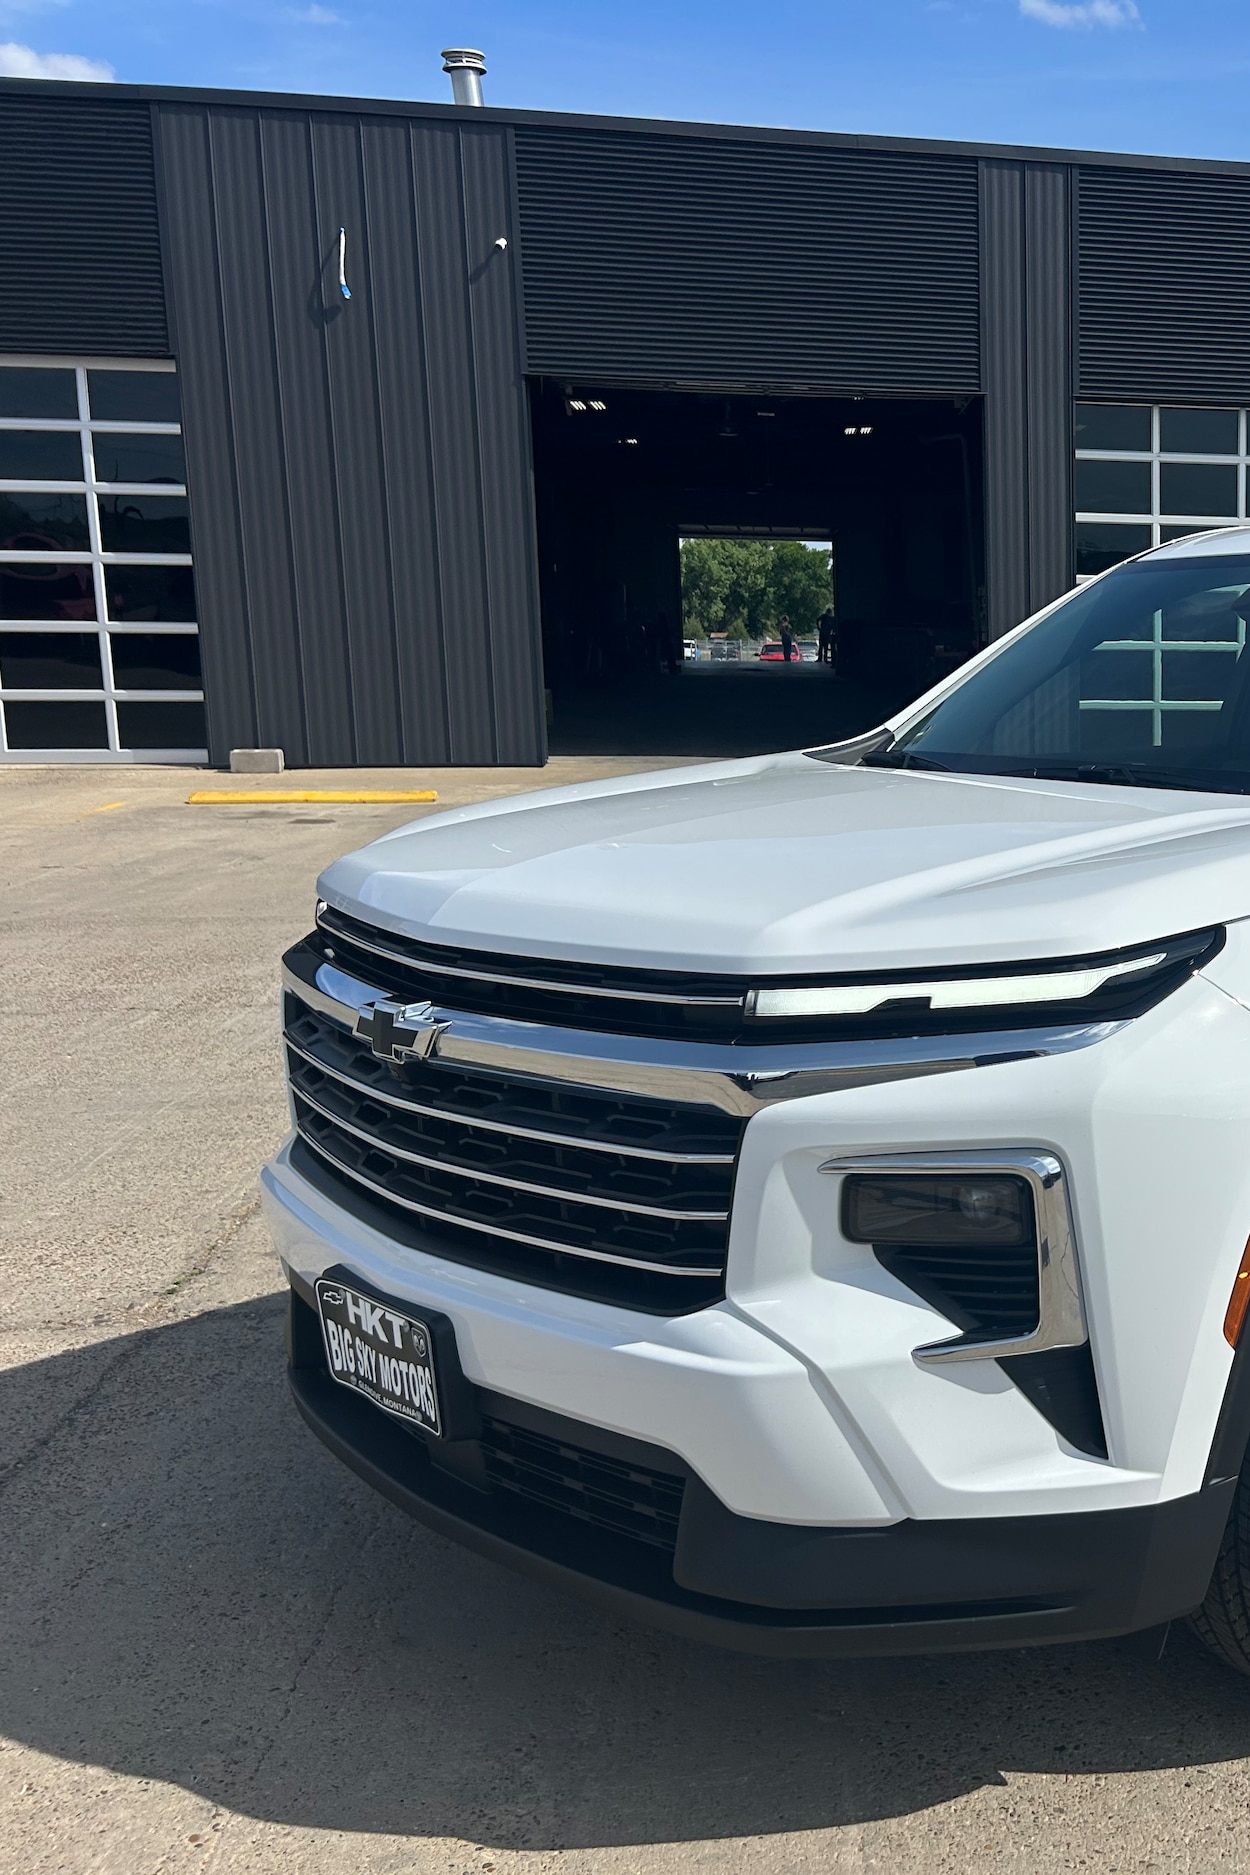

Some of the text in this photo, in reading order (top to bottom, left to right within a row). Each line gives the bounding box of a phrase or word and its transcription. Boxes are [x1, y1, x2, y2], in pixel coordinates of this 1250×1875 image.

[346, 1291, 406, 1349] HKT
[327, 1319, 436, 1423] BIG SKY MOTORS
